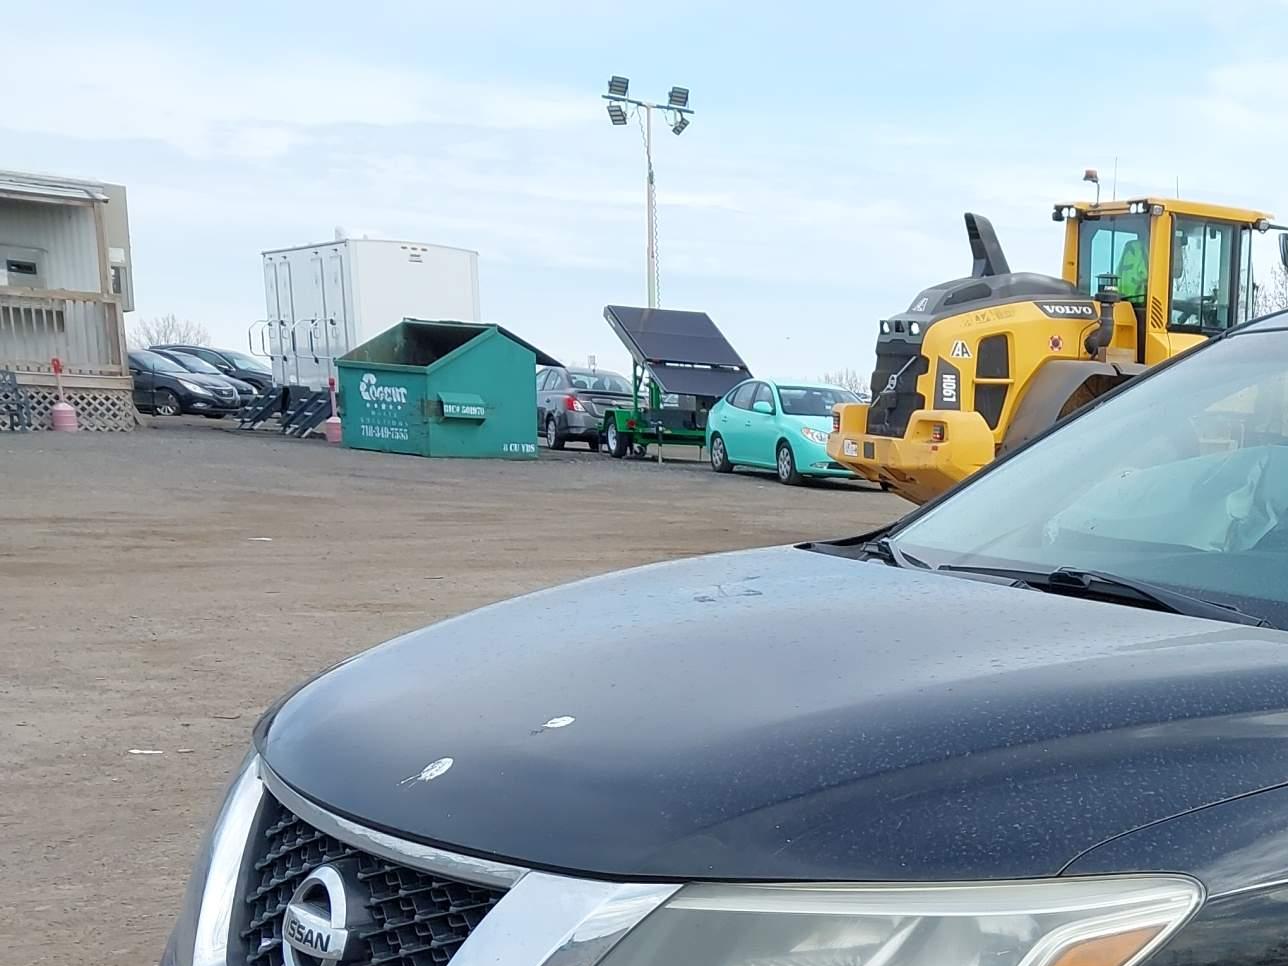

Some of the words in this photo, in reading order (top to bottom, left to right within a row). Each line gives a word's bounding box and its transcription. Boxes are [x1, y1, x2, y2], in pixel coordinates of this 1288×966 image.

[1043, 305, 1092, 314] VOLVO
[943, 374, 956, 402] L90H
[361, 425, 408, 440] 718-349-7555
[509, 443, 519, 451] CU
[521, 444, 535, 453] YDS
